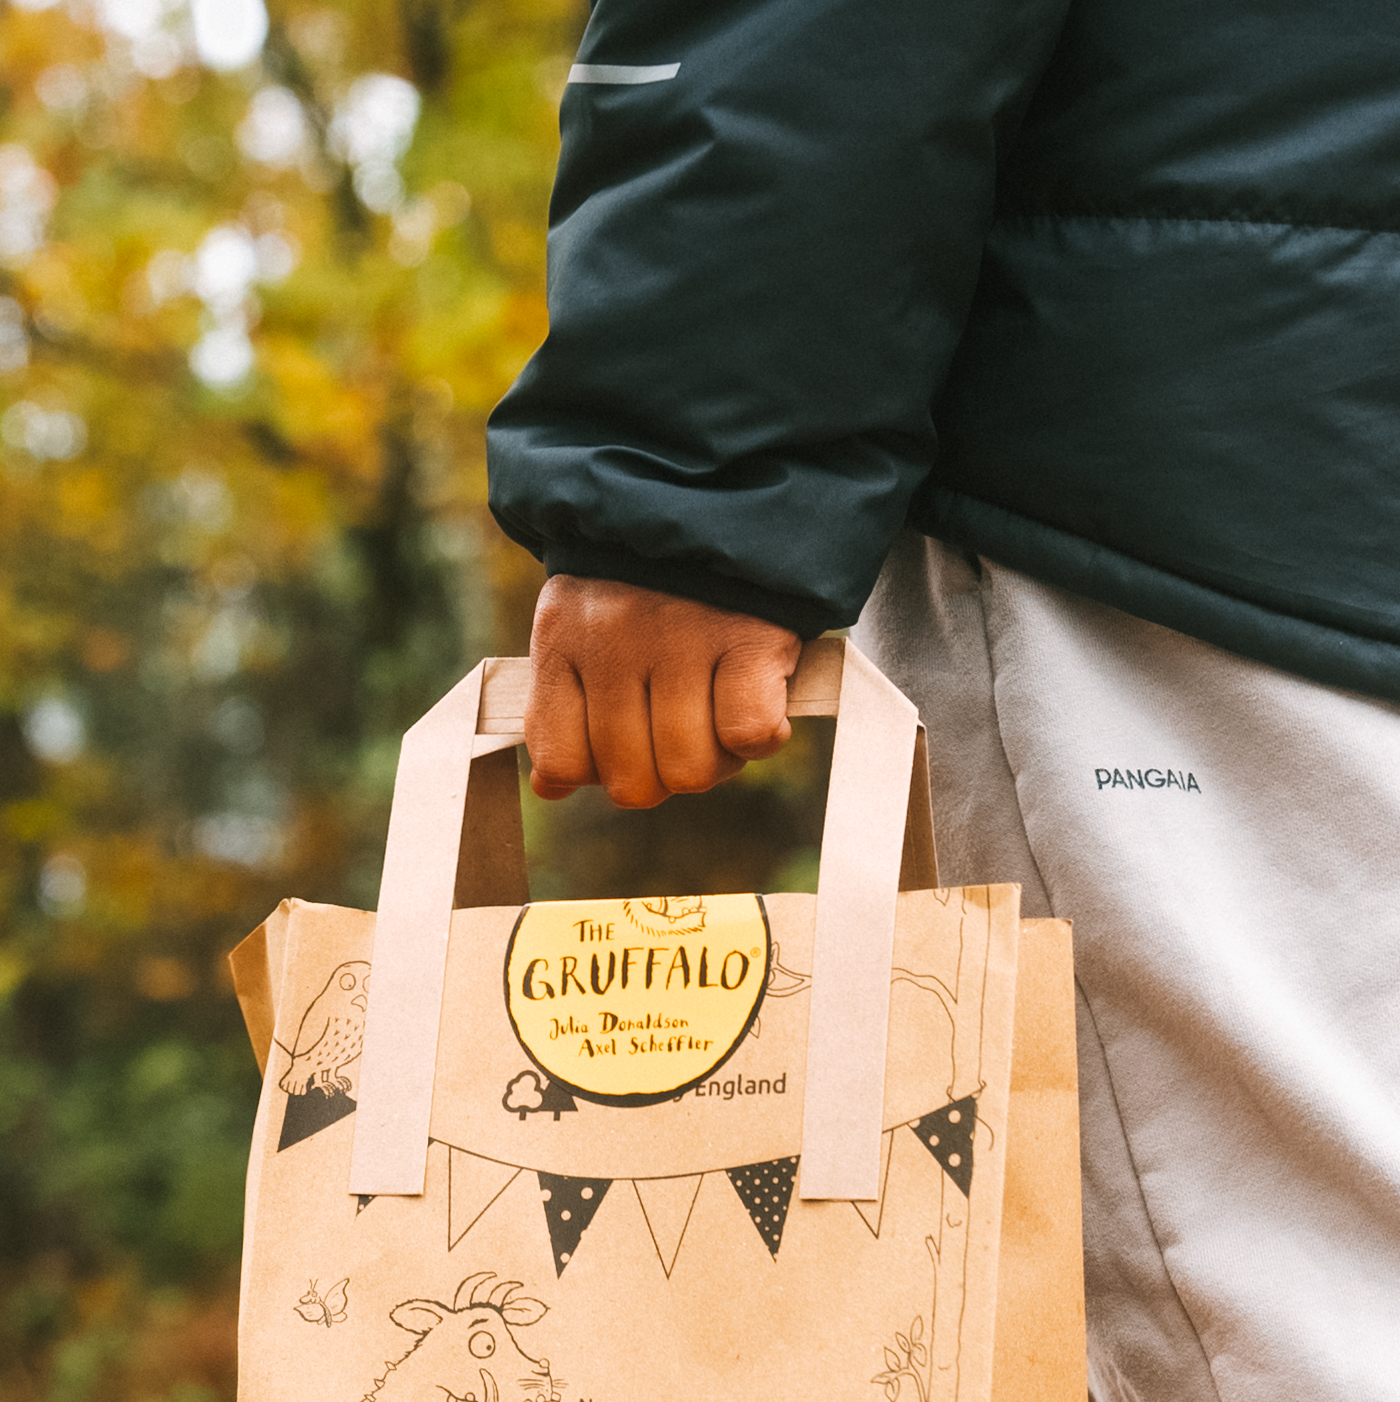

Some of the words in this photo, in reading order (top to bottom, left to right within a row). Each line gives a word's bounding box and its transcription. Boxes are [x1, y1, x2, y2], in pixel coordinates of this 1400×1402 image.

[1094, 767, 1202, 794] PANGAIA
[573, 919, 616, 943] THE
[548, 1015, 589, 1041] Julia
[599, 1011, 689, 1035] Donaldson
[578, 1037, 617, 1058] Axel
[628, 1035, 714, 1055] Scheffler
